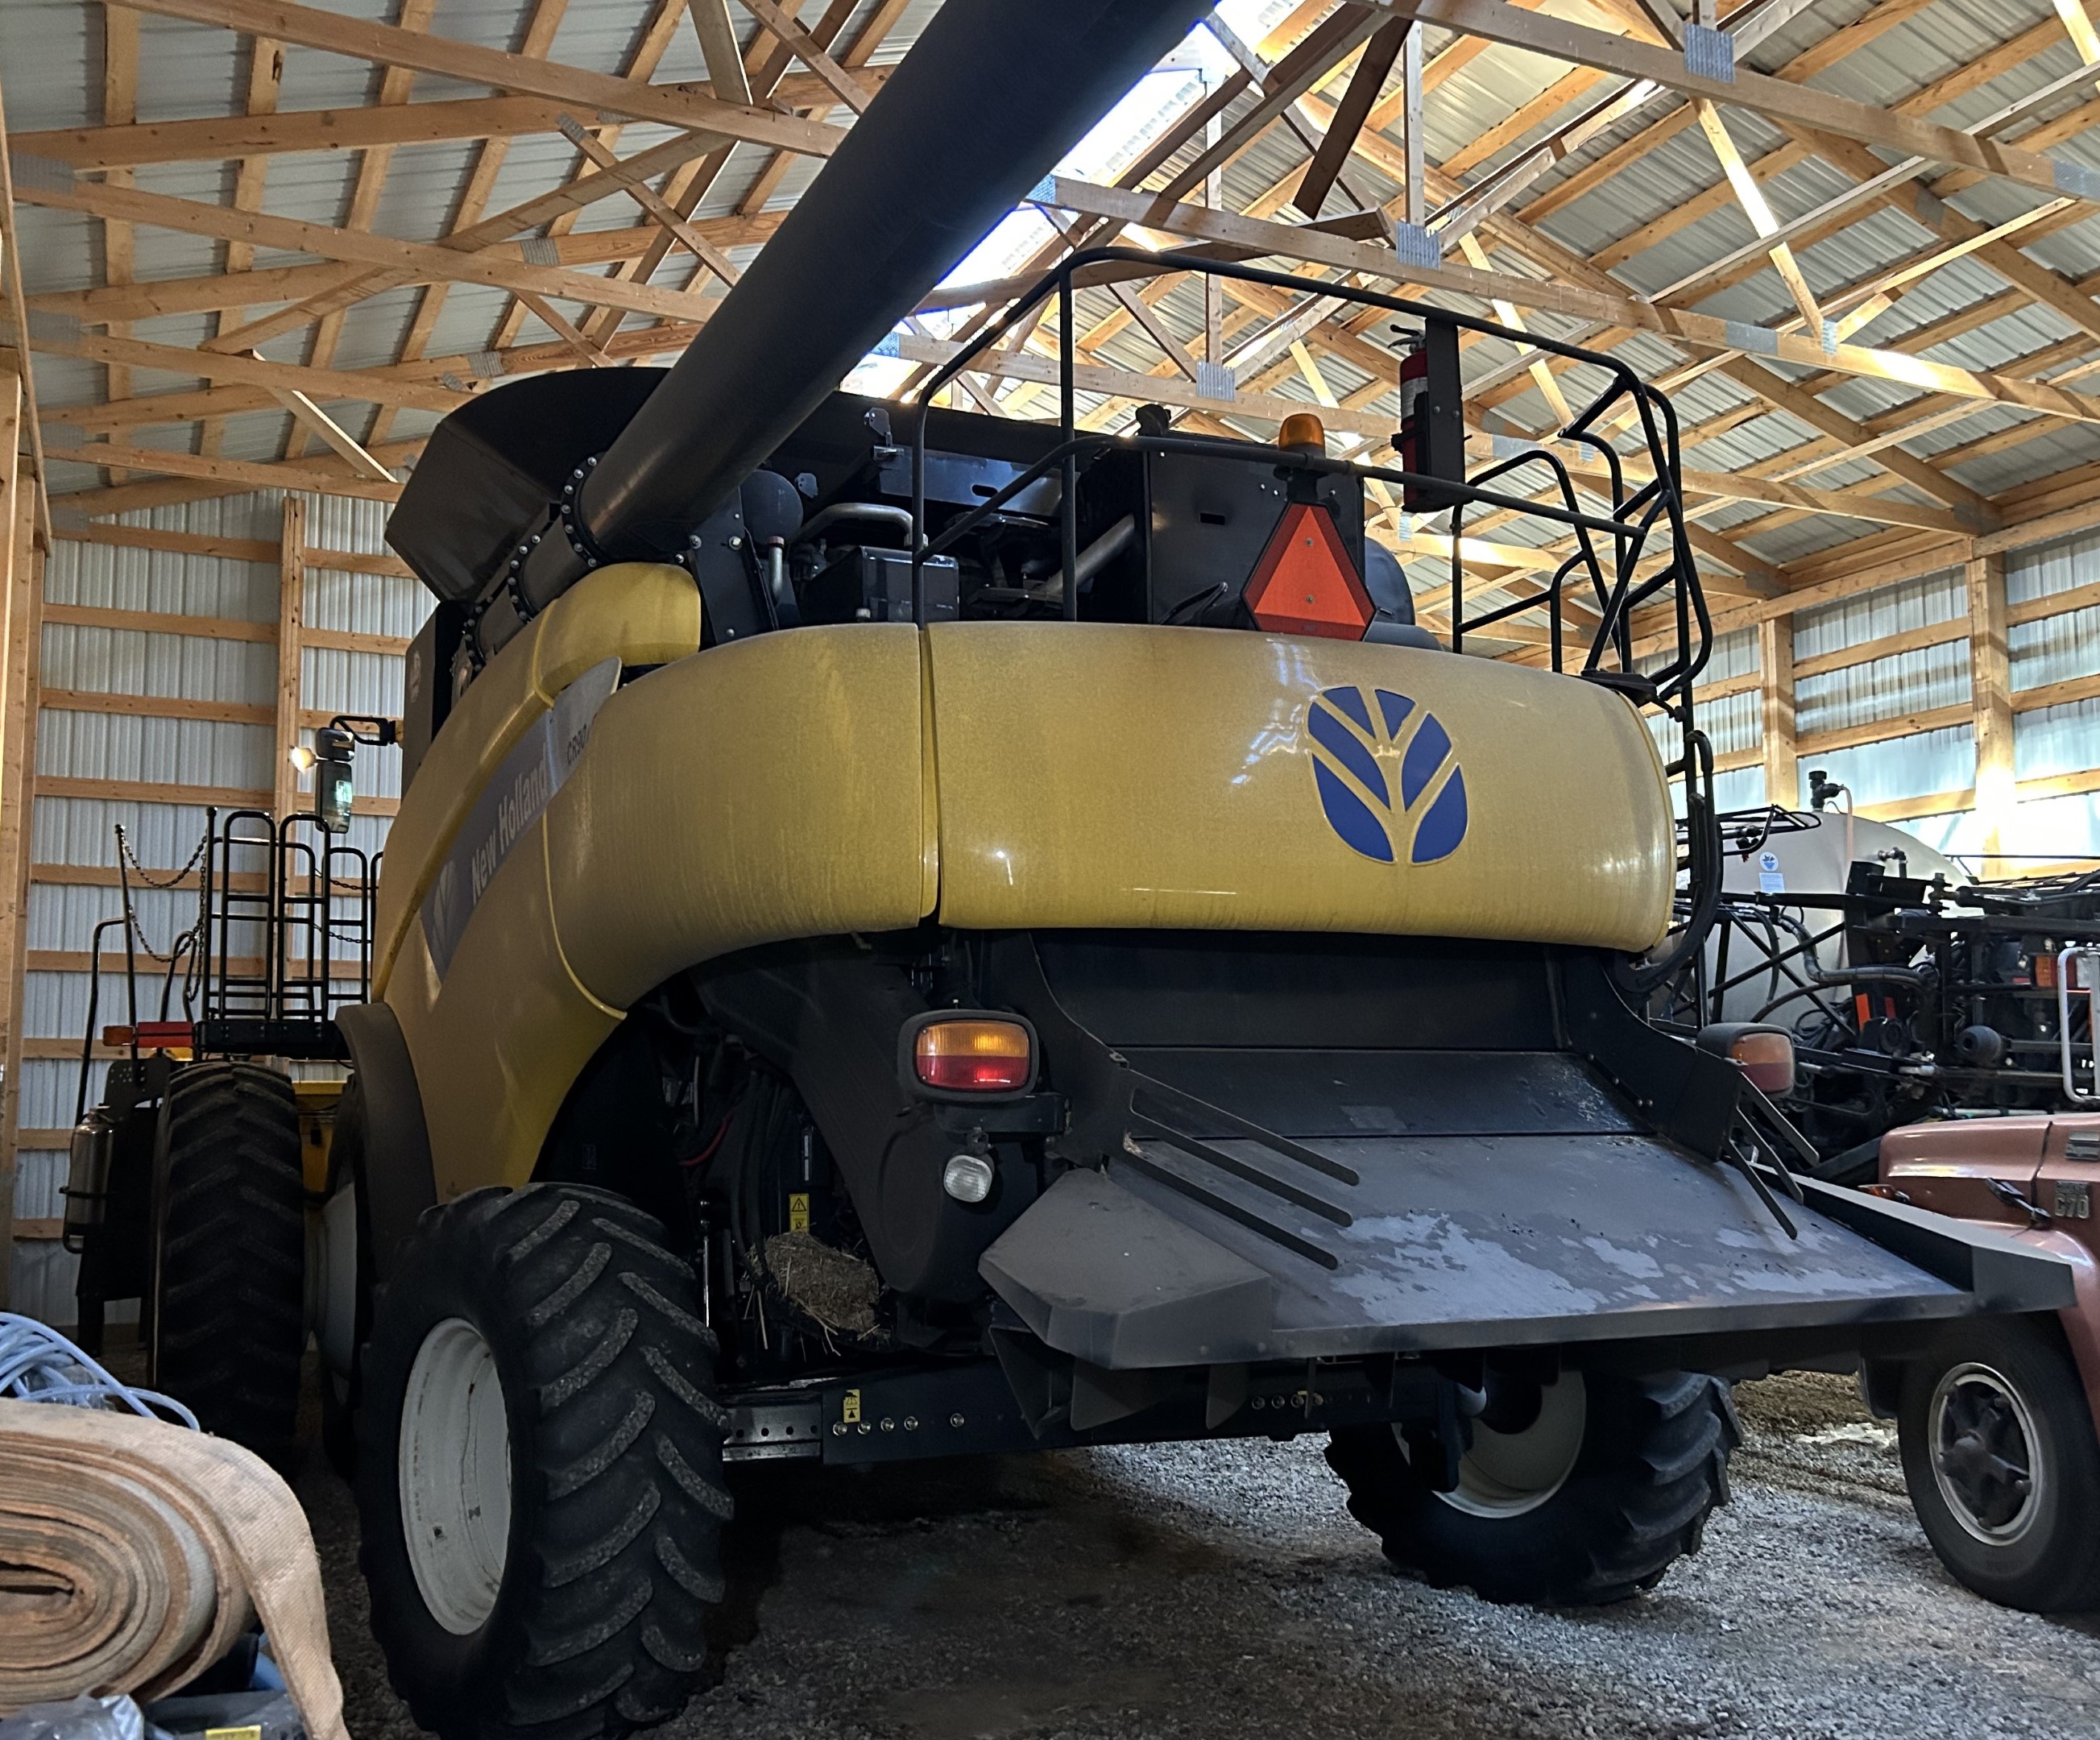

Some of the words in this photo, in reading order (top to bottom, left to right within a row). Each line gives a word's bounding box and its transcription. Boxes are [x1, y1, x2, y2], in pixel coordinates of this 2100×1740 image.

[567, 723, 590, 765] CR90
[472, 827, 496, 906] New
[499, 741, 549, 856] Holland
